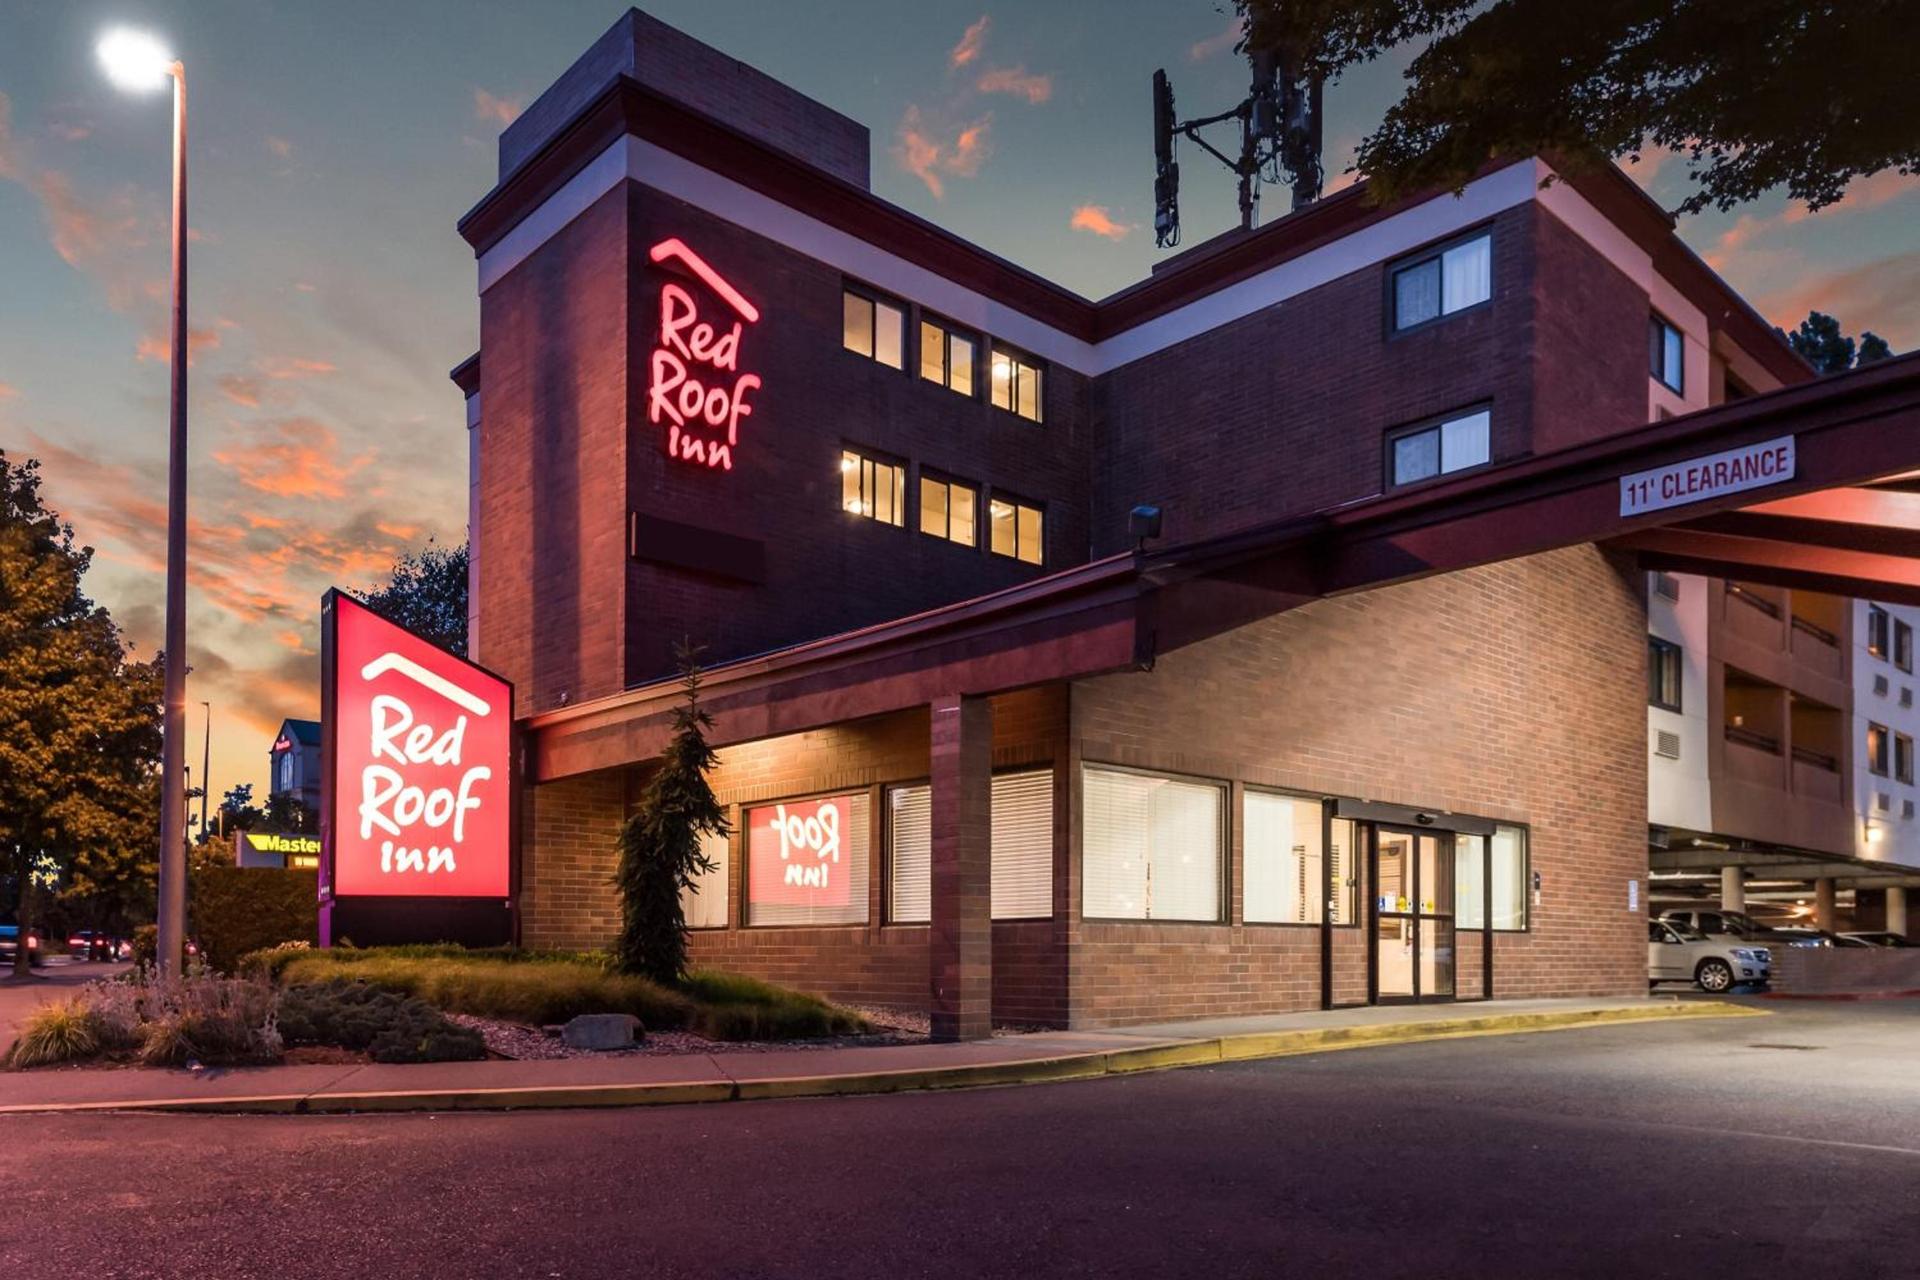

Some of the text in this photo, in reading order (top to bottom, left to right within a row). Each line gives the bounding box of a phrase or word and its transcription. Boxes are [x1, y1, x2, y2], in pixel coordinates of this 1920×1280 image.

[661, 283, 742, 372] Red
[650, 349, 761, 446] Roof
[668, 425, 732, 470] Inn
[1628, 446, 1788, 507] 11' CLEARANCE
[370, 694, 468, 766] Red
[358, 764, 492, 843] Roof
[380, 841, 457, 874] Inn
